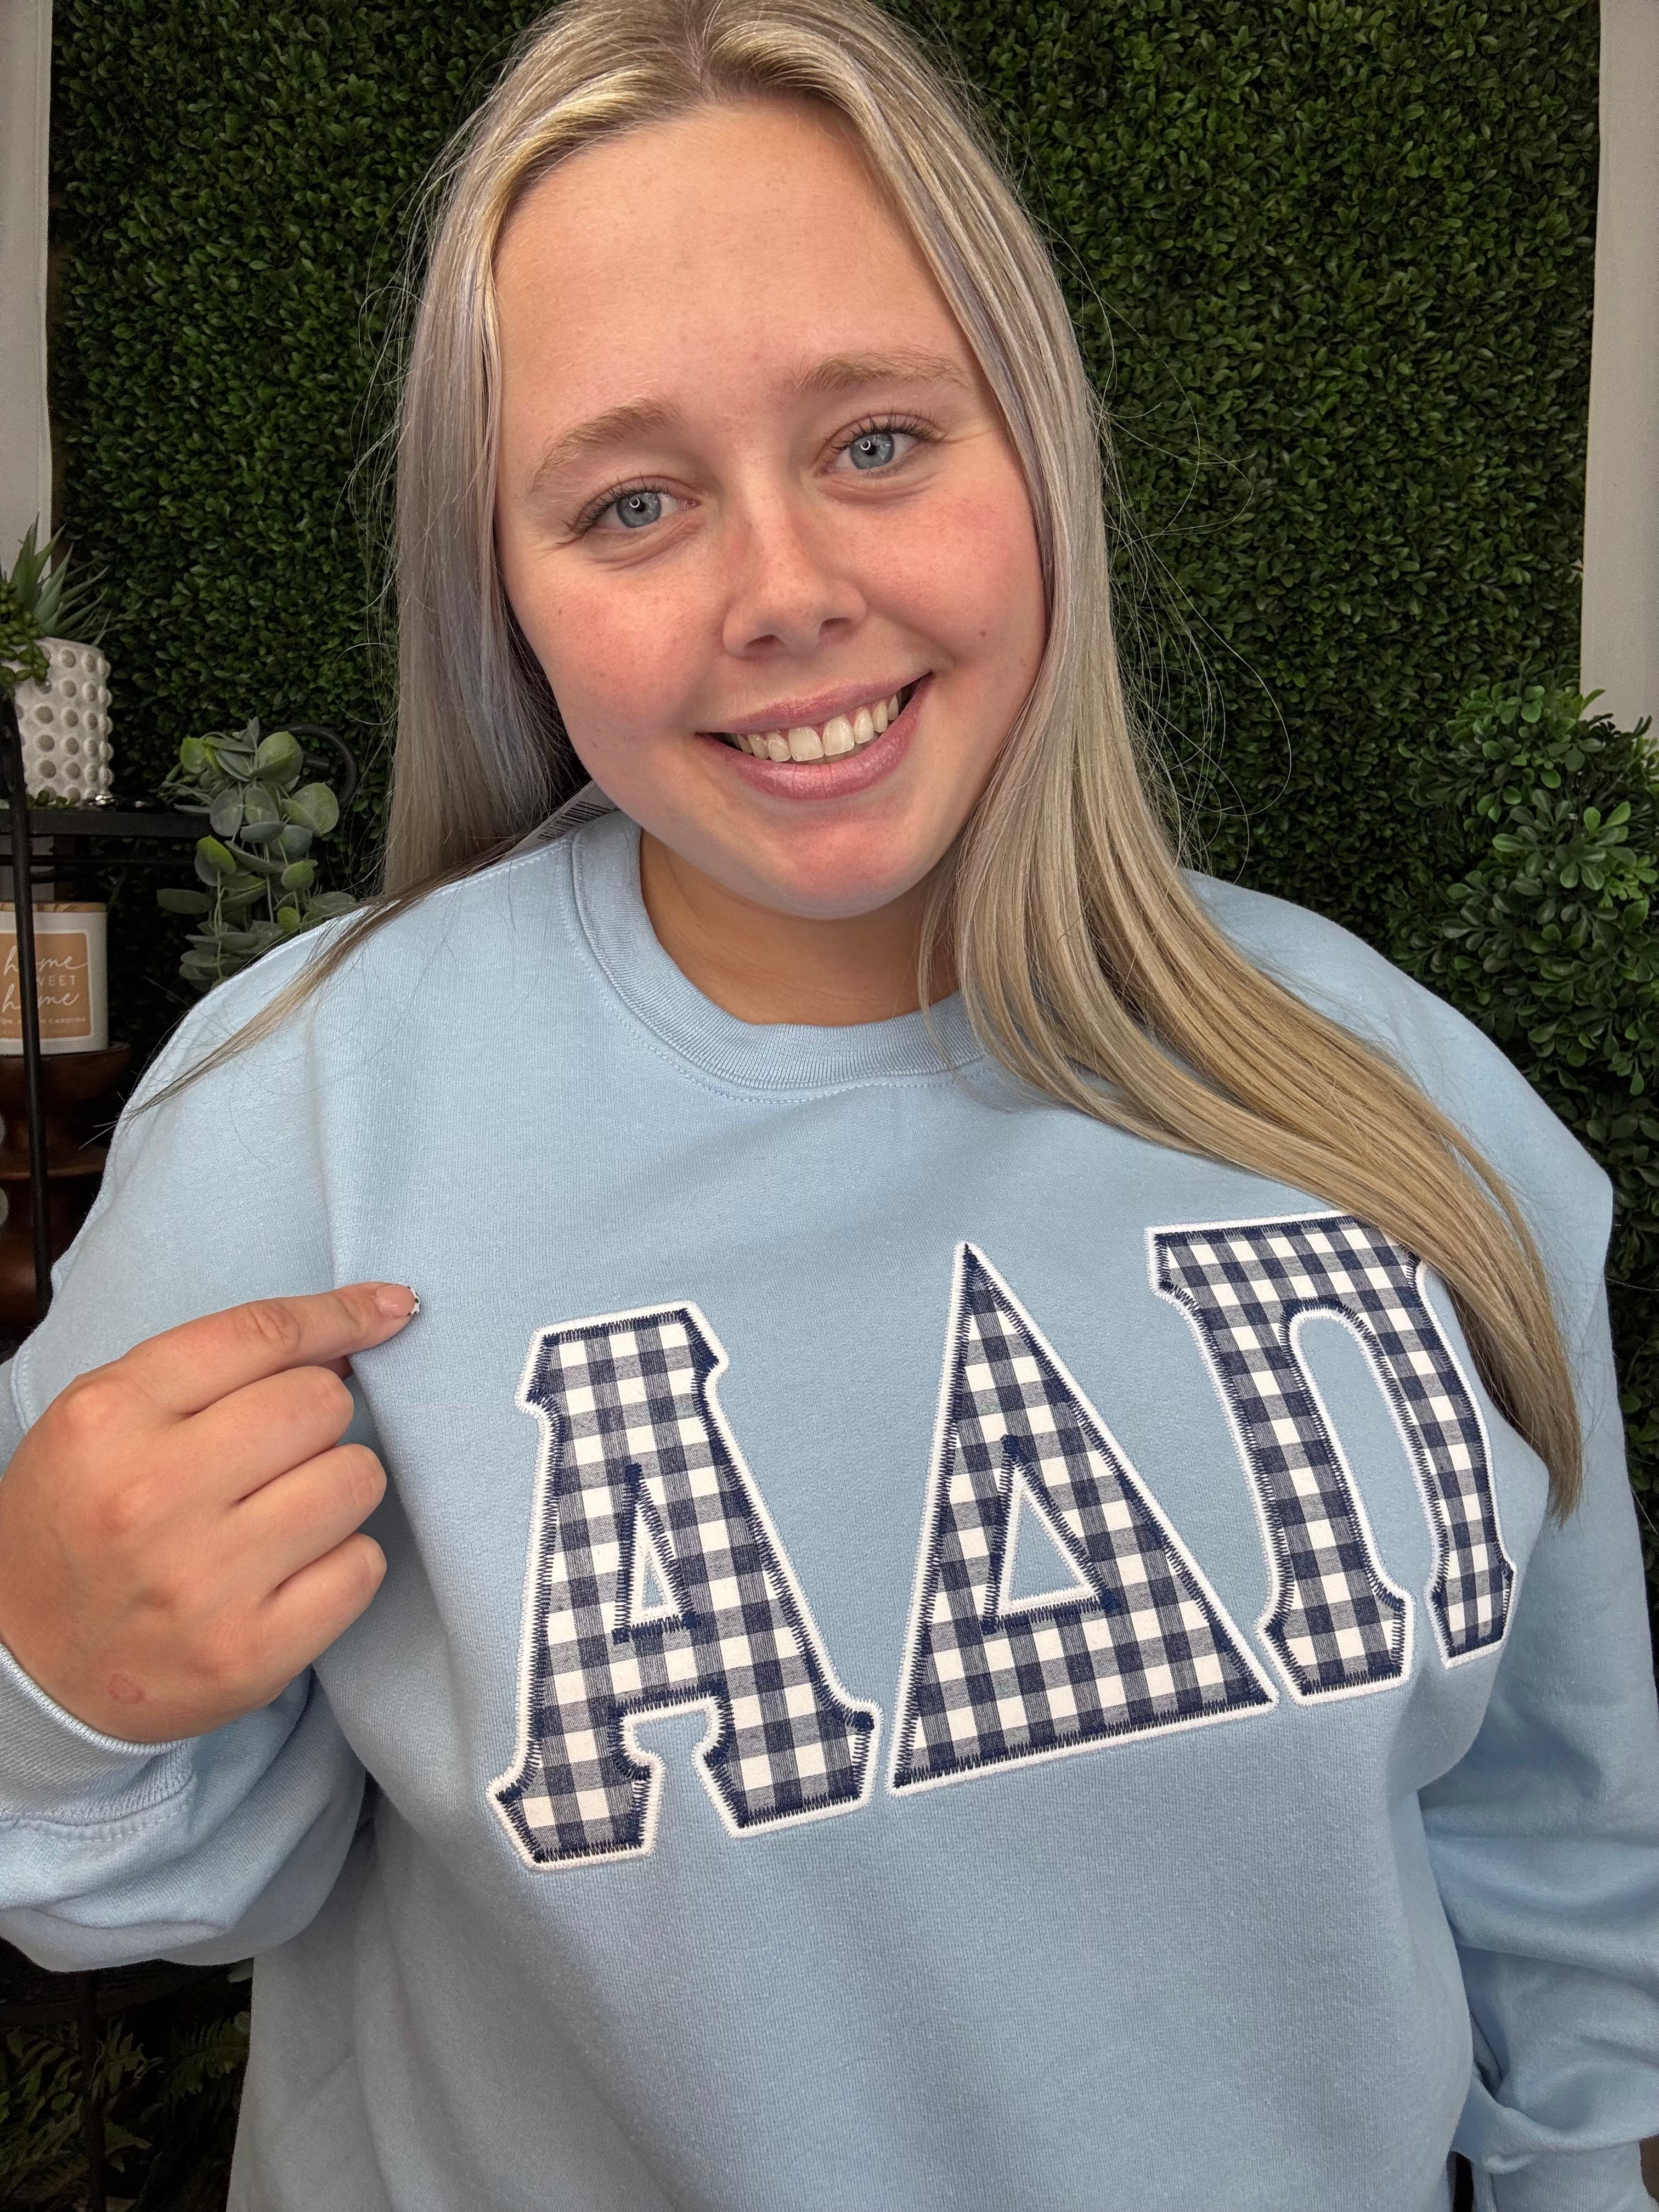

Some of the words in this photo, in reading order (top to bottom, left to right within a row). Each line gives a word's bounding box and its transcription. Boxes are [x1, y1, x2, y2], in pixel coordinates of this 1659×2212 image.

[3, 945, 88, 975] hme
[36, 974, 76, 986] WEET
[2, 983, 80, 1013] hme
